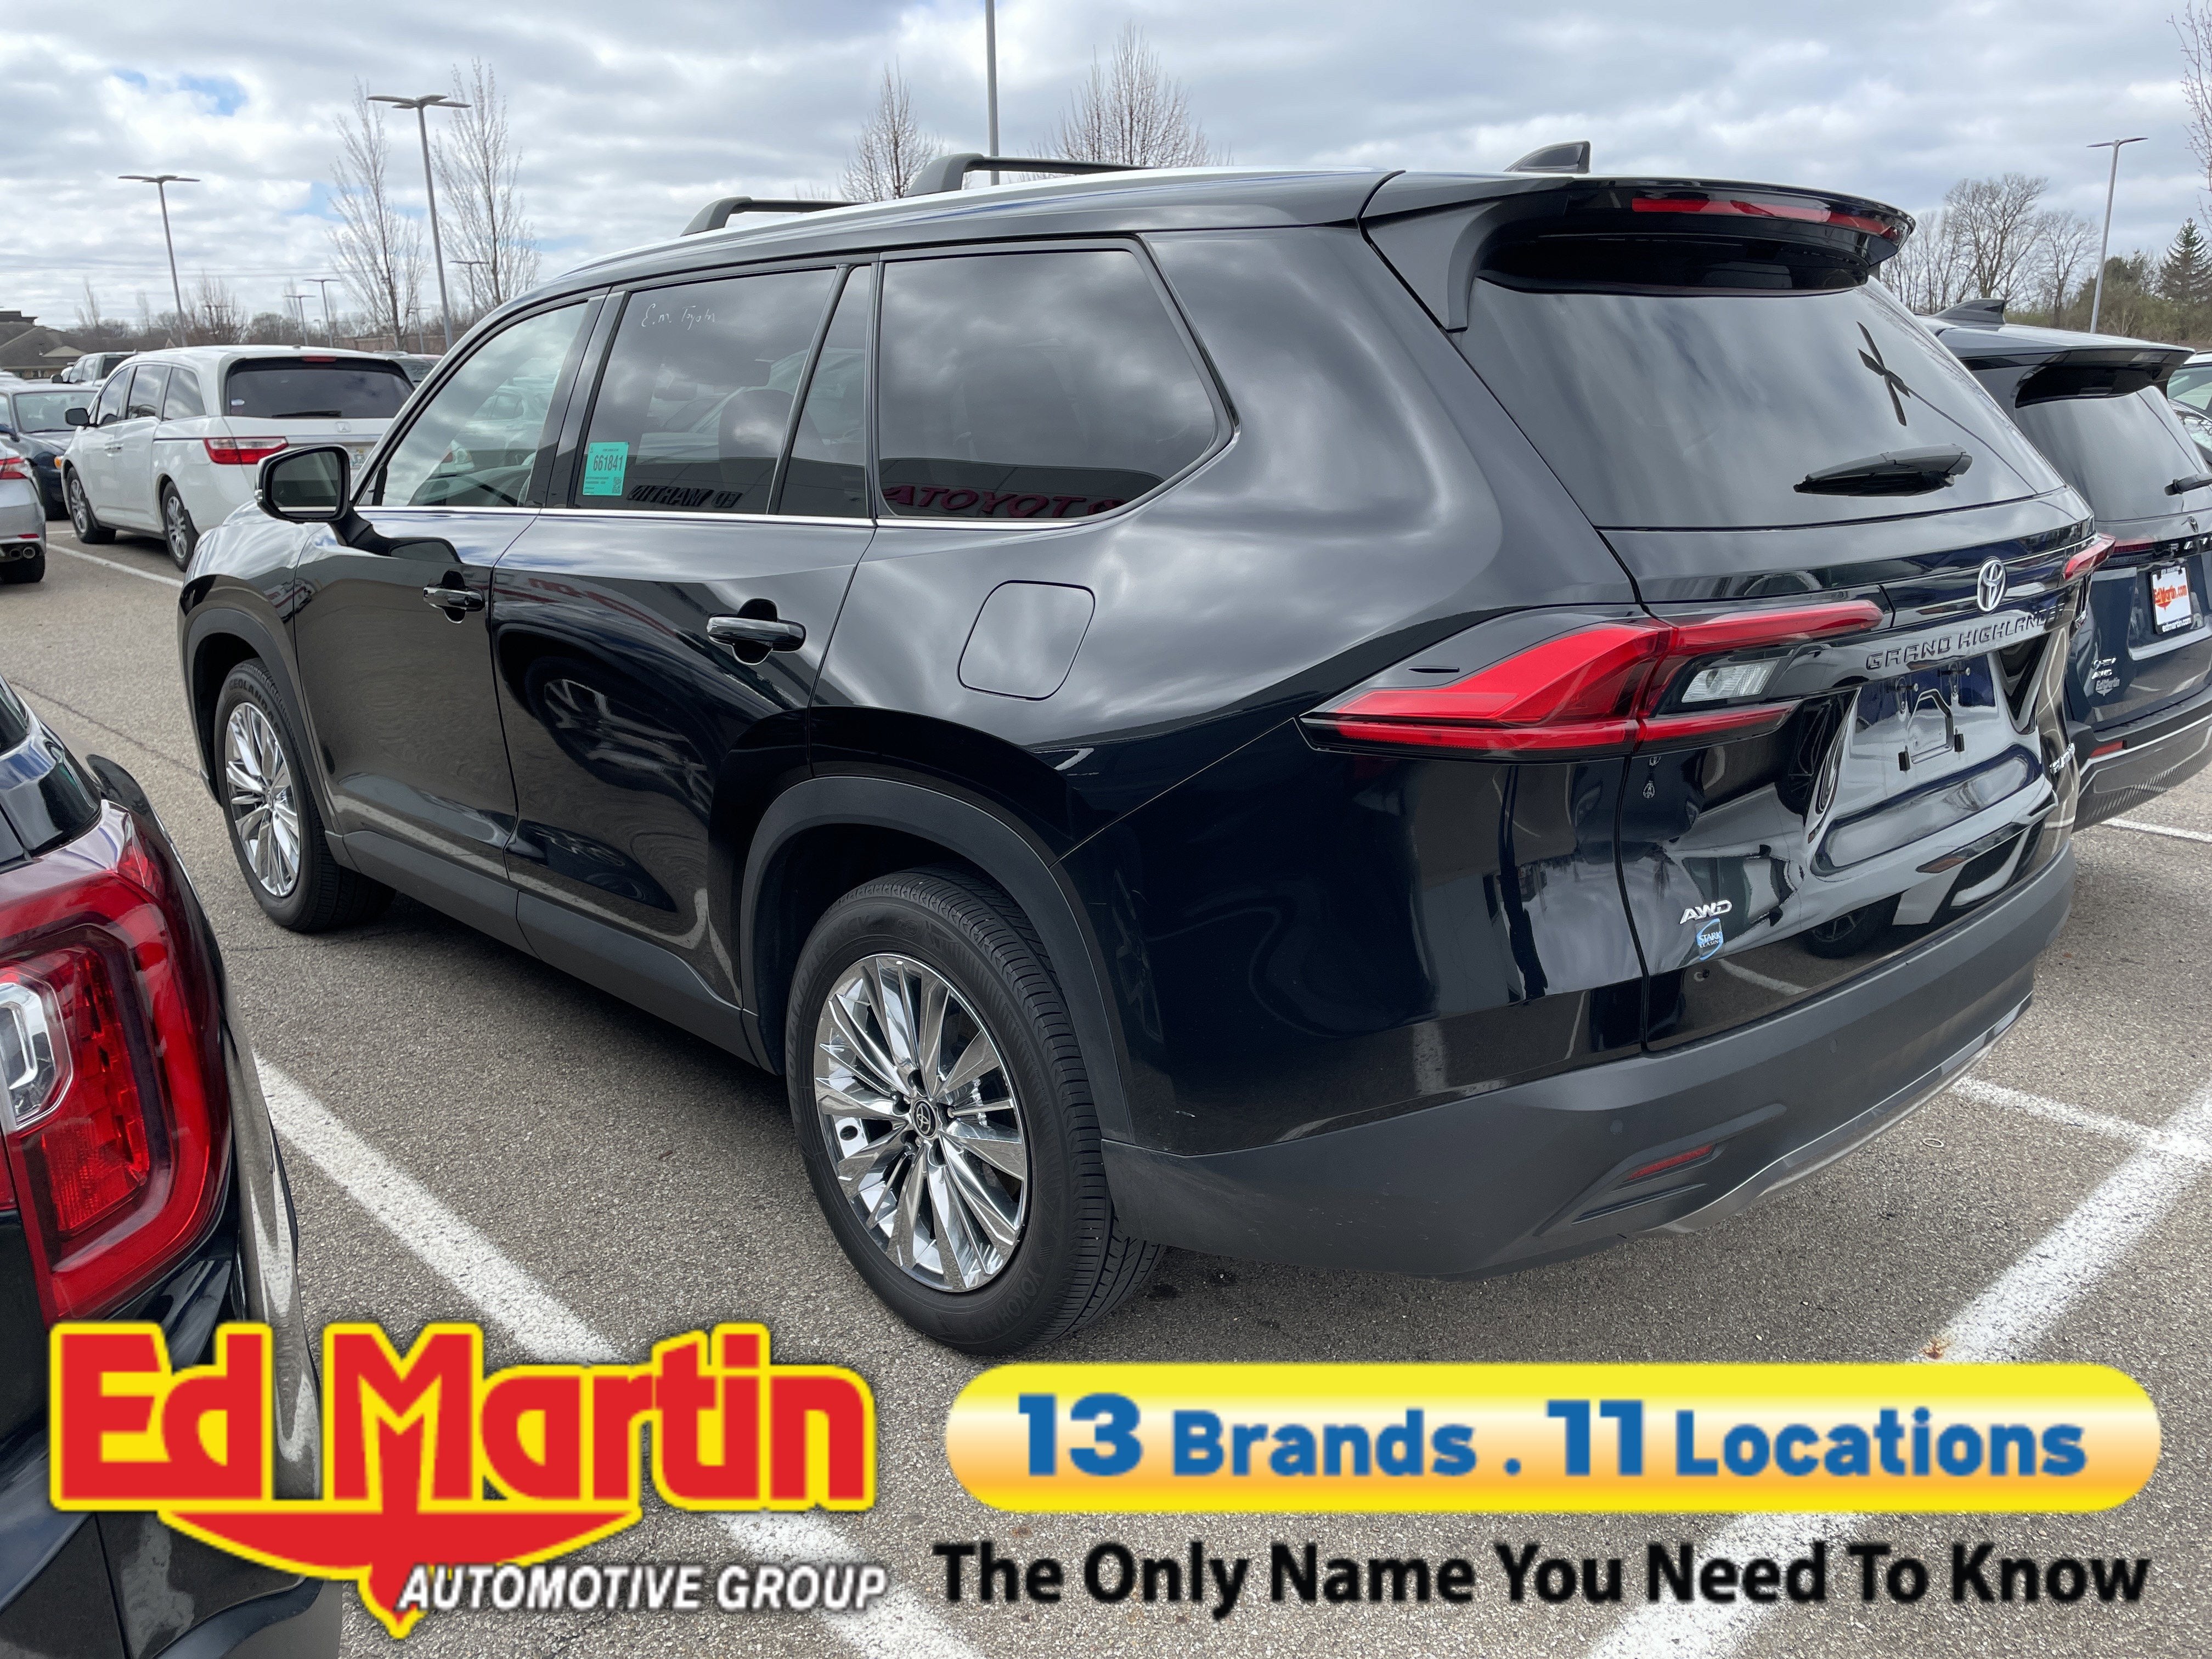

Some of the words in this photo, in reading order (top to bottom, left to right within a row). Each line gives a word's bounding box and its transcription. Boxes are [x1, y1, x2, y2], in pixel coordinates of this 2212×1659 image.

[593, 454, 623, 471] 661841
[2169, 537, 2212, 554] RAV
[1866, 635, 1952, 670] GRAND
[1957, 602, 2066, 650] HIGHLANDER
[1679, 899, 1733, 924] AWD
[1699, 930, 1723, 943] STARK
